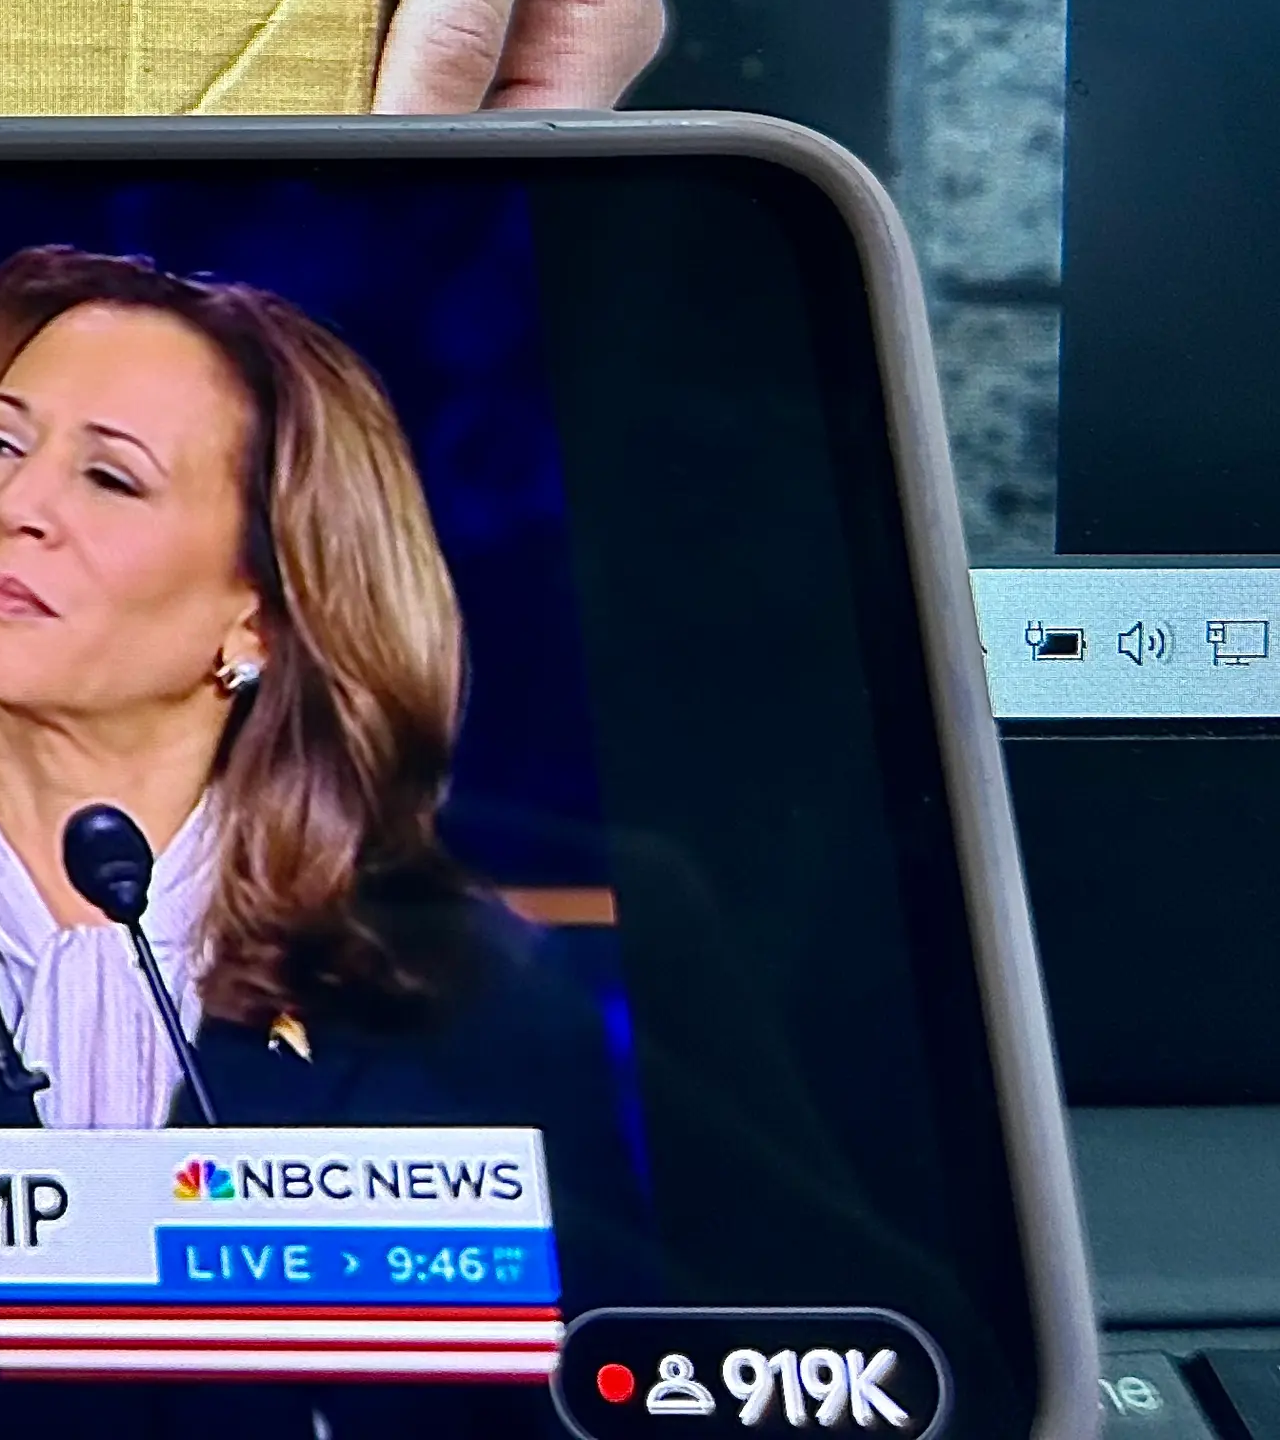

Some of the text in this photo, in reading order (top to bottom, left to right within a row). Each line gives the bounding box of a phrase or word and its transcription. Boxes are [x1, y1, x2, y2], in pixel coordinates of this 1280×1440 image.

[185, 1244, 313, 1281] LIVE
[385, 1246, 485, 1283] 9:46
[721, 1347, 912, 1428] 919K
